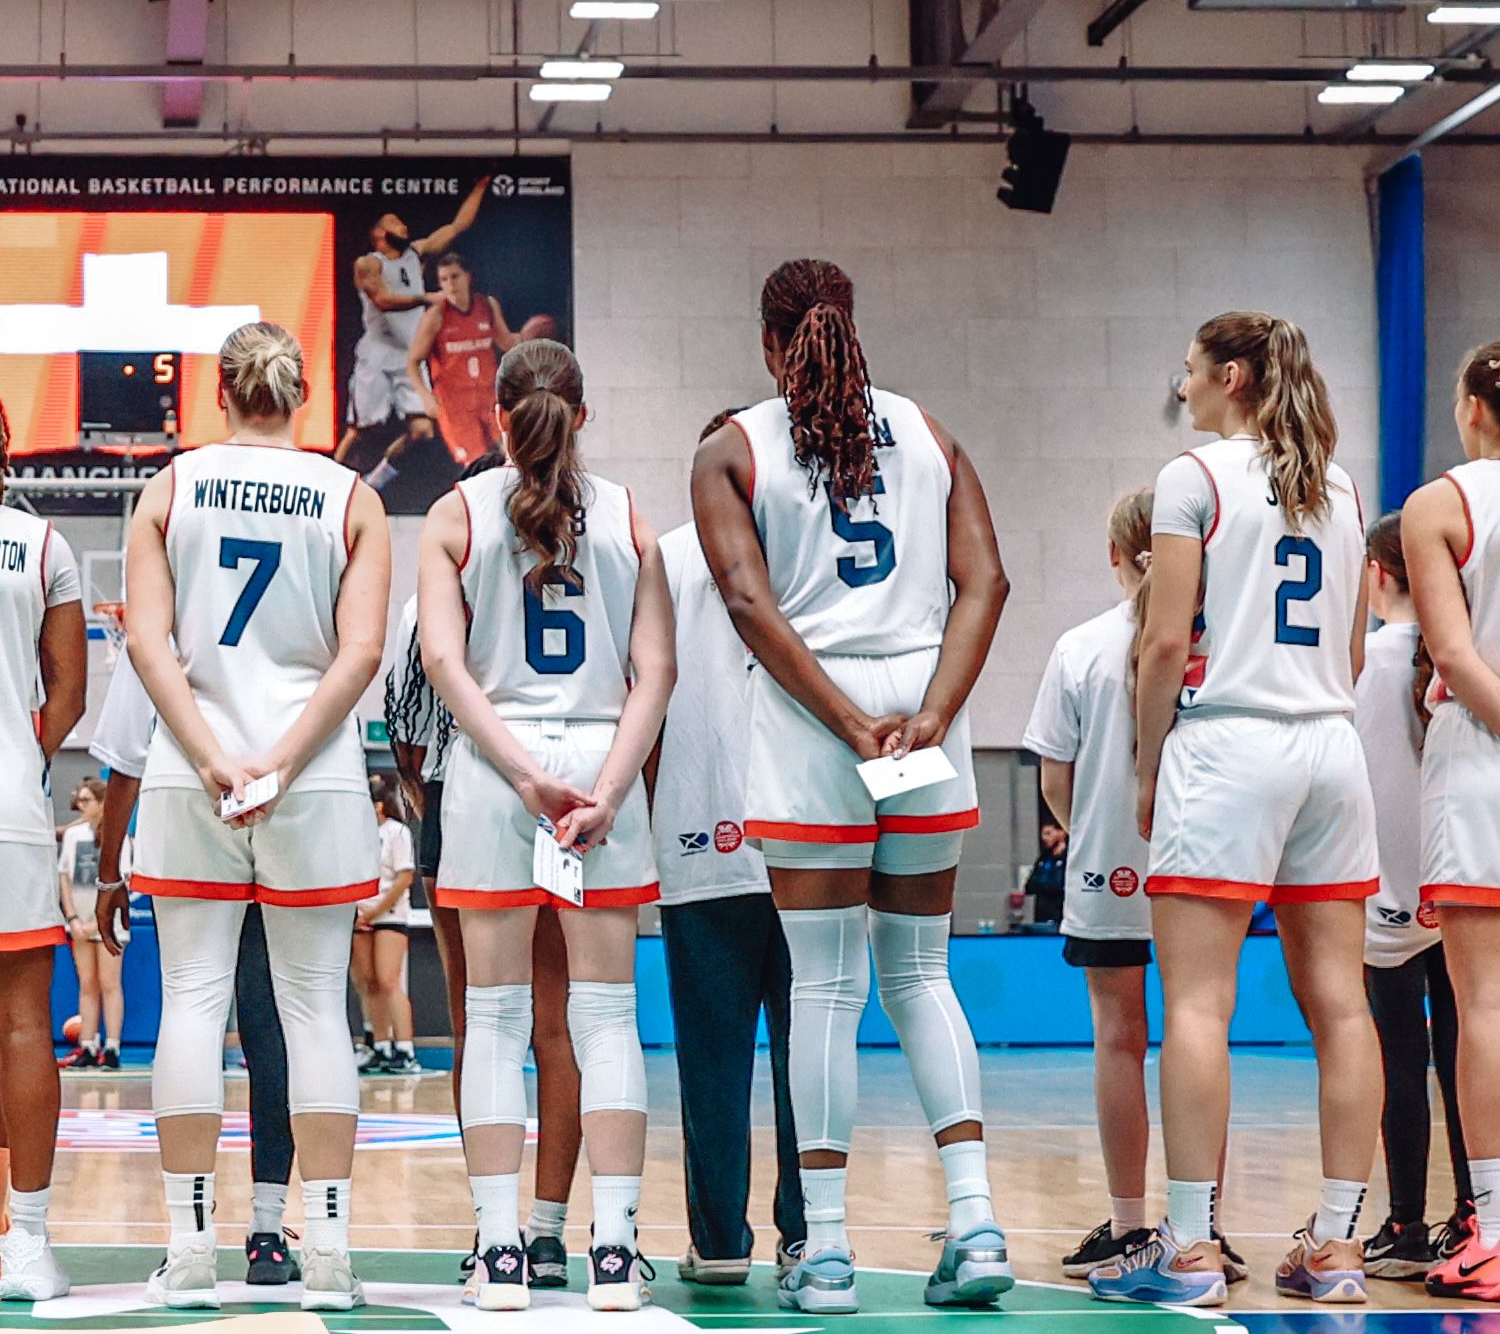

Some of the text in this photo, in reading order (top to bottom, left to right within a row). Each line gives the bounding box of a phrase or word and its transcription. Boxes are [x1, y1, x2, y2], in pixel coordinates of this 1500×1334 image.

[88, 177, 215, 195] BASKETBALL
[223, 177, 372, 195] PERFORMANCE
[382, 177, 458, 195] CENTRE
[194, 478, 326, 520] WINTERBURN
[824, 475, 897, 588] 5
[217, 536, 283, 647] 7
[522, 564, 586, 675] 6
[1275, 534, 1323, 647] 2
